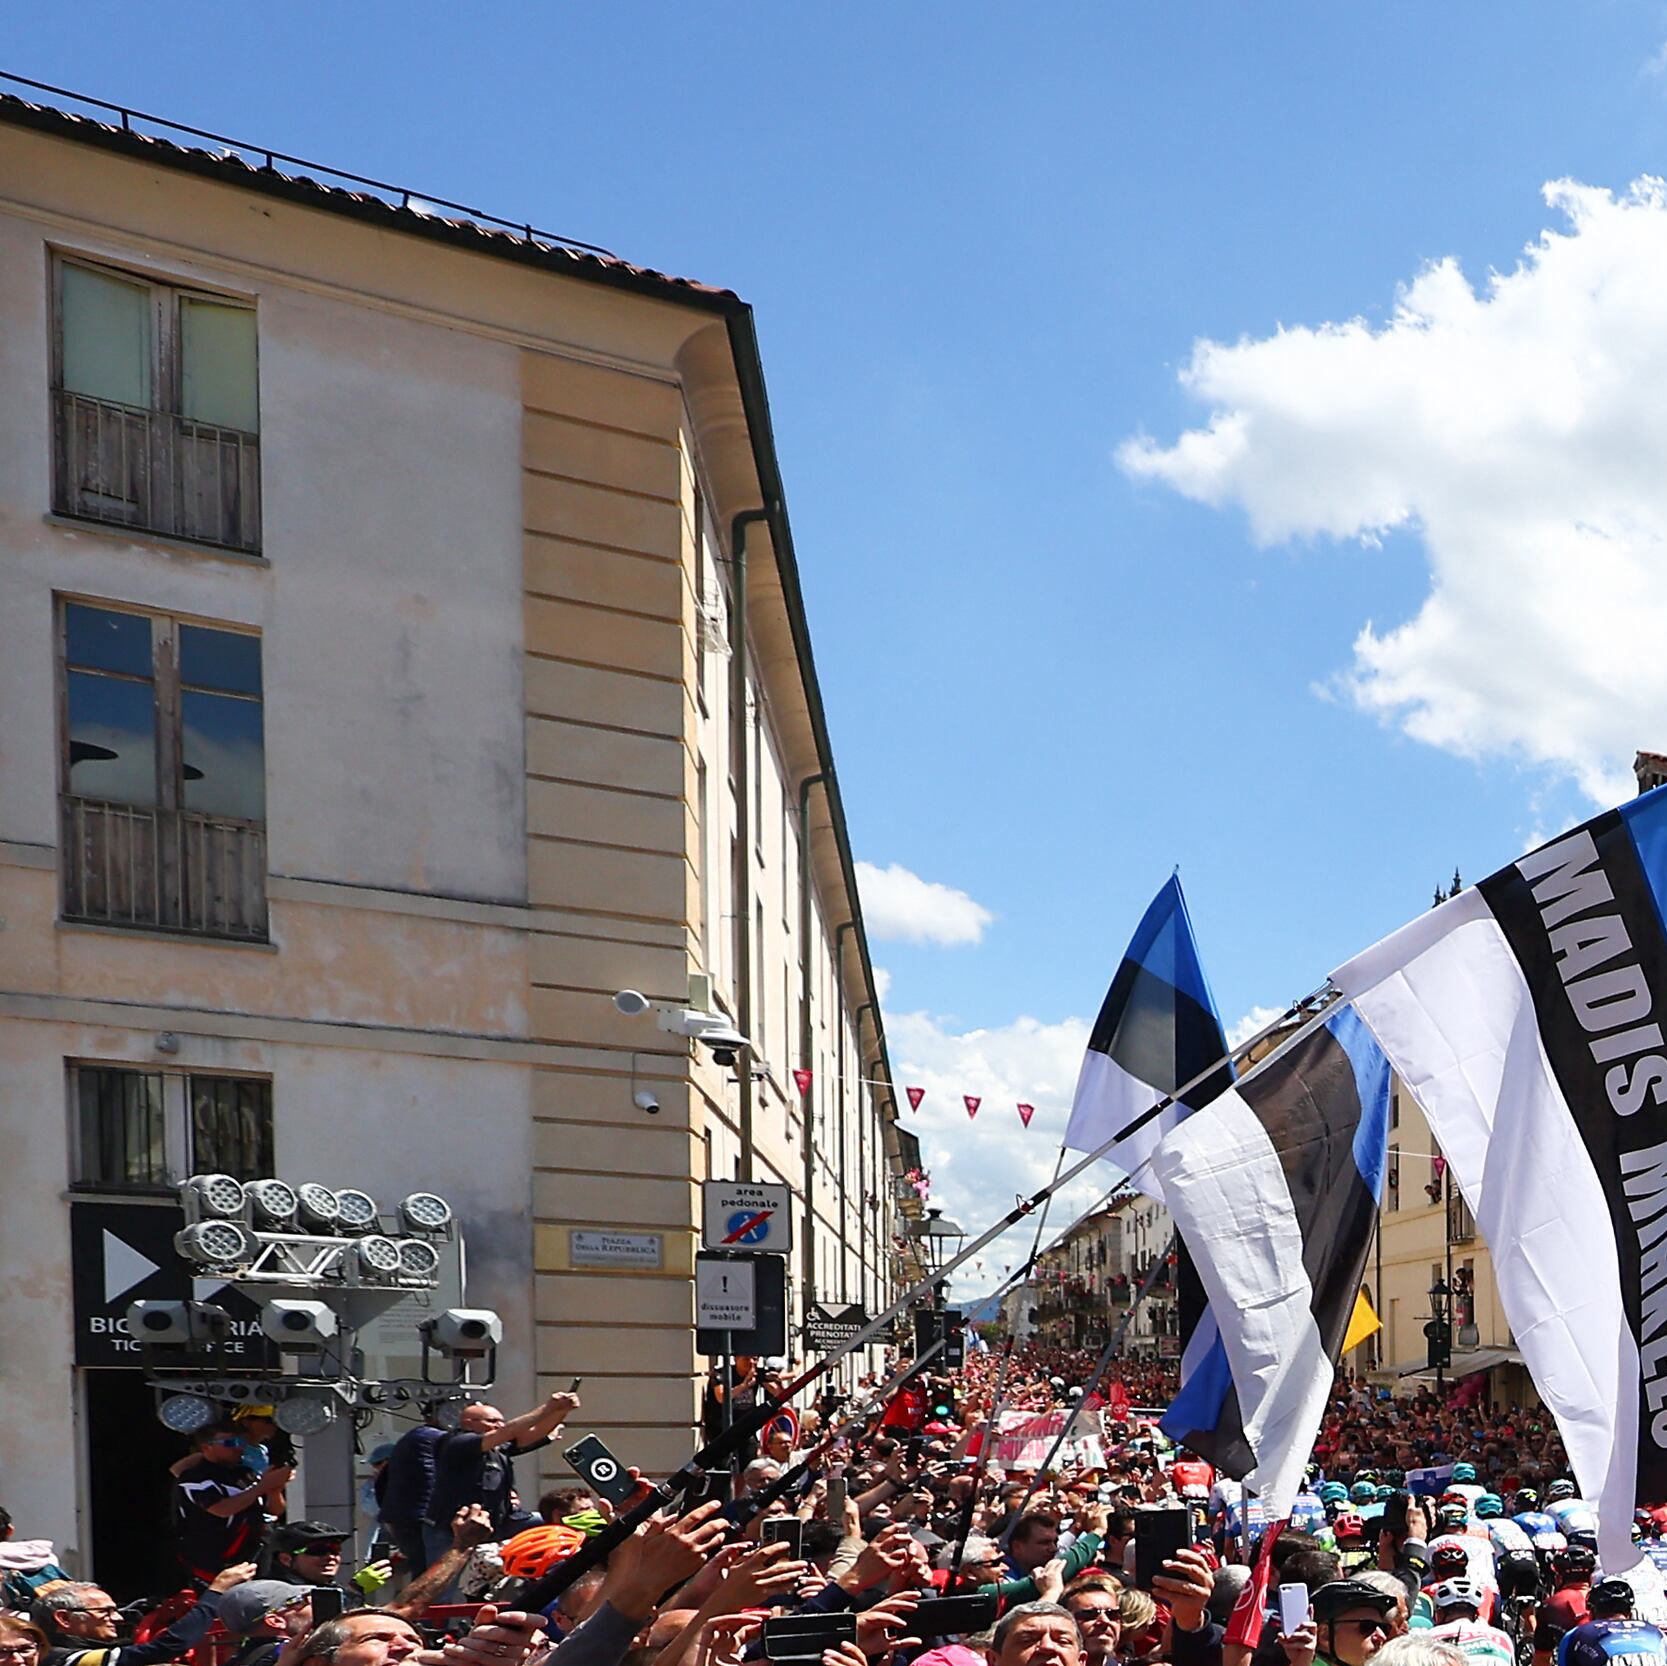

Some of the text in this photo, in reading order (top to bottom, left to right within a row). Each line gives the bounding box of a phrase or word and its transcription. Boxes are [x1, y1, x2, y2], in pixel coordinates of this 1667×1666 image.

[736, 1188, 764, 1197] area
[721, 1199, 779, 1209] pedonale
[701, 1303, 750, 1312] dissuasore
[709, 1313, 742, 1322] mobile
[806, 1322, 862, 1331] ACCREDITATI
[810, 1331, 856, 1339] PRENOTAT
